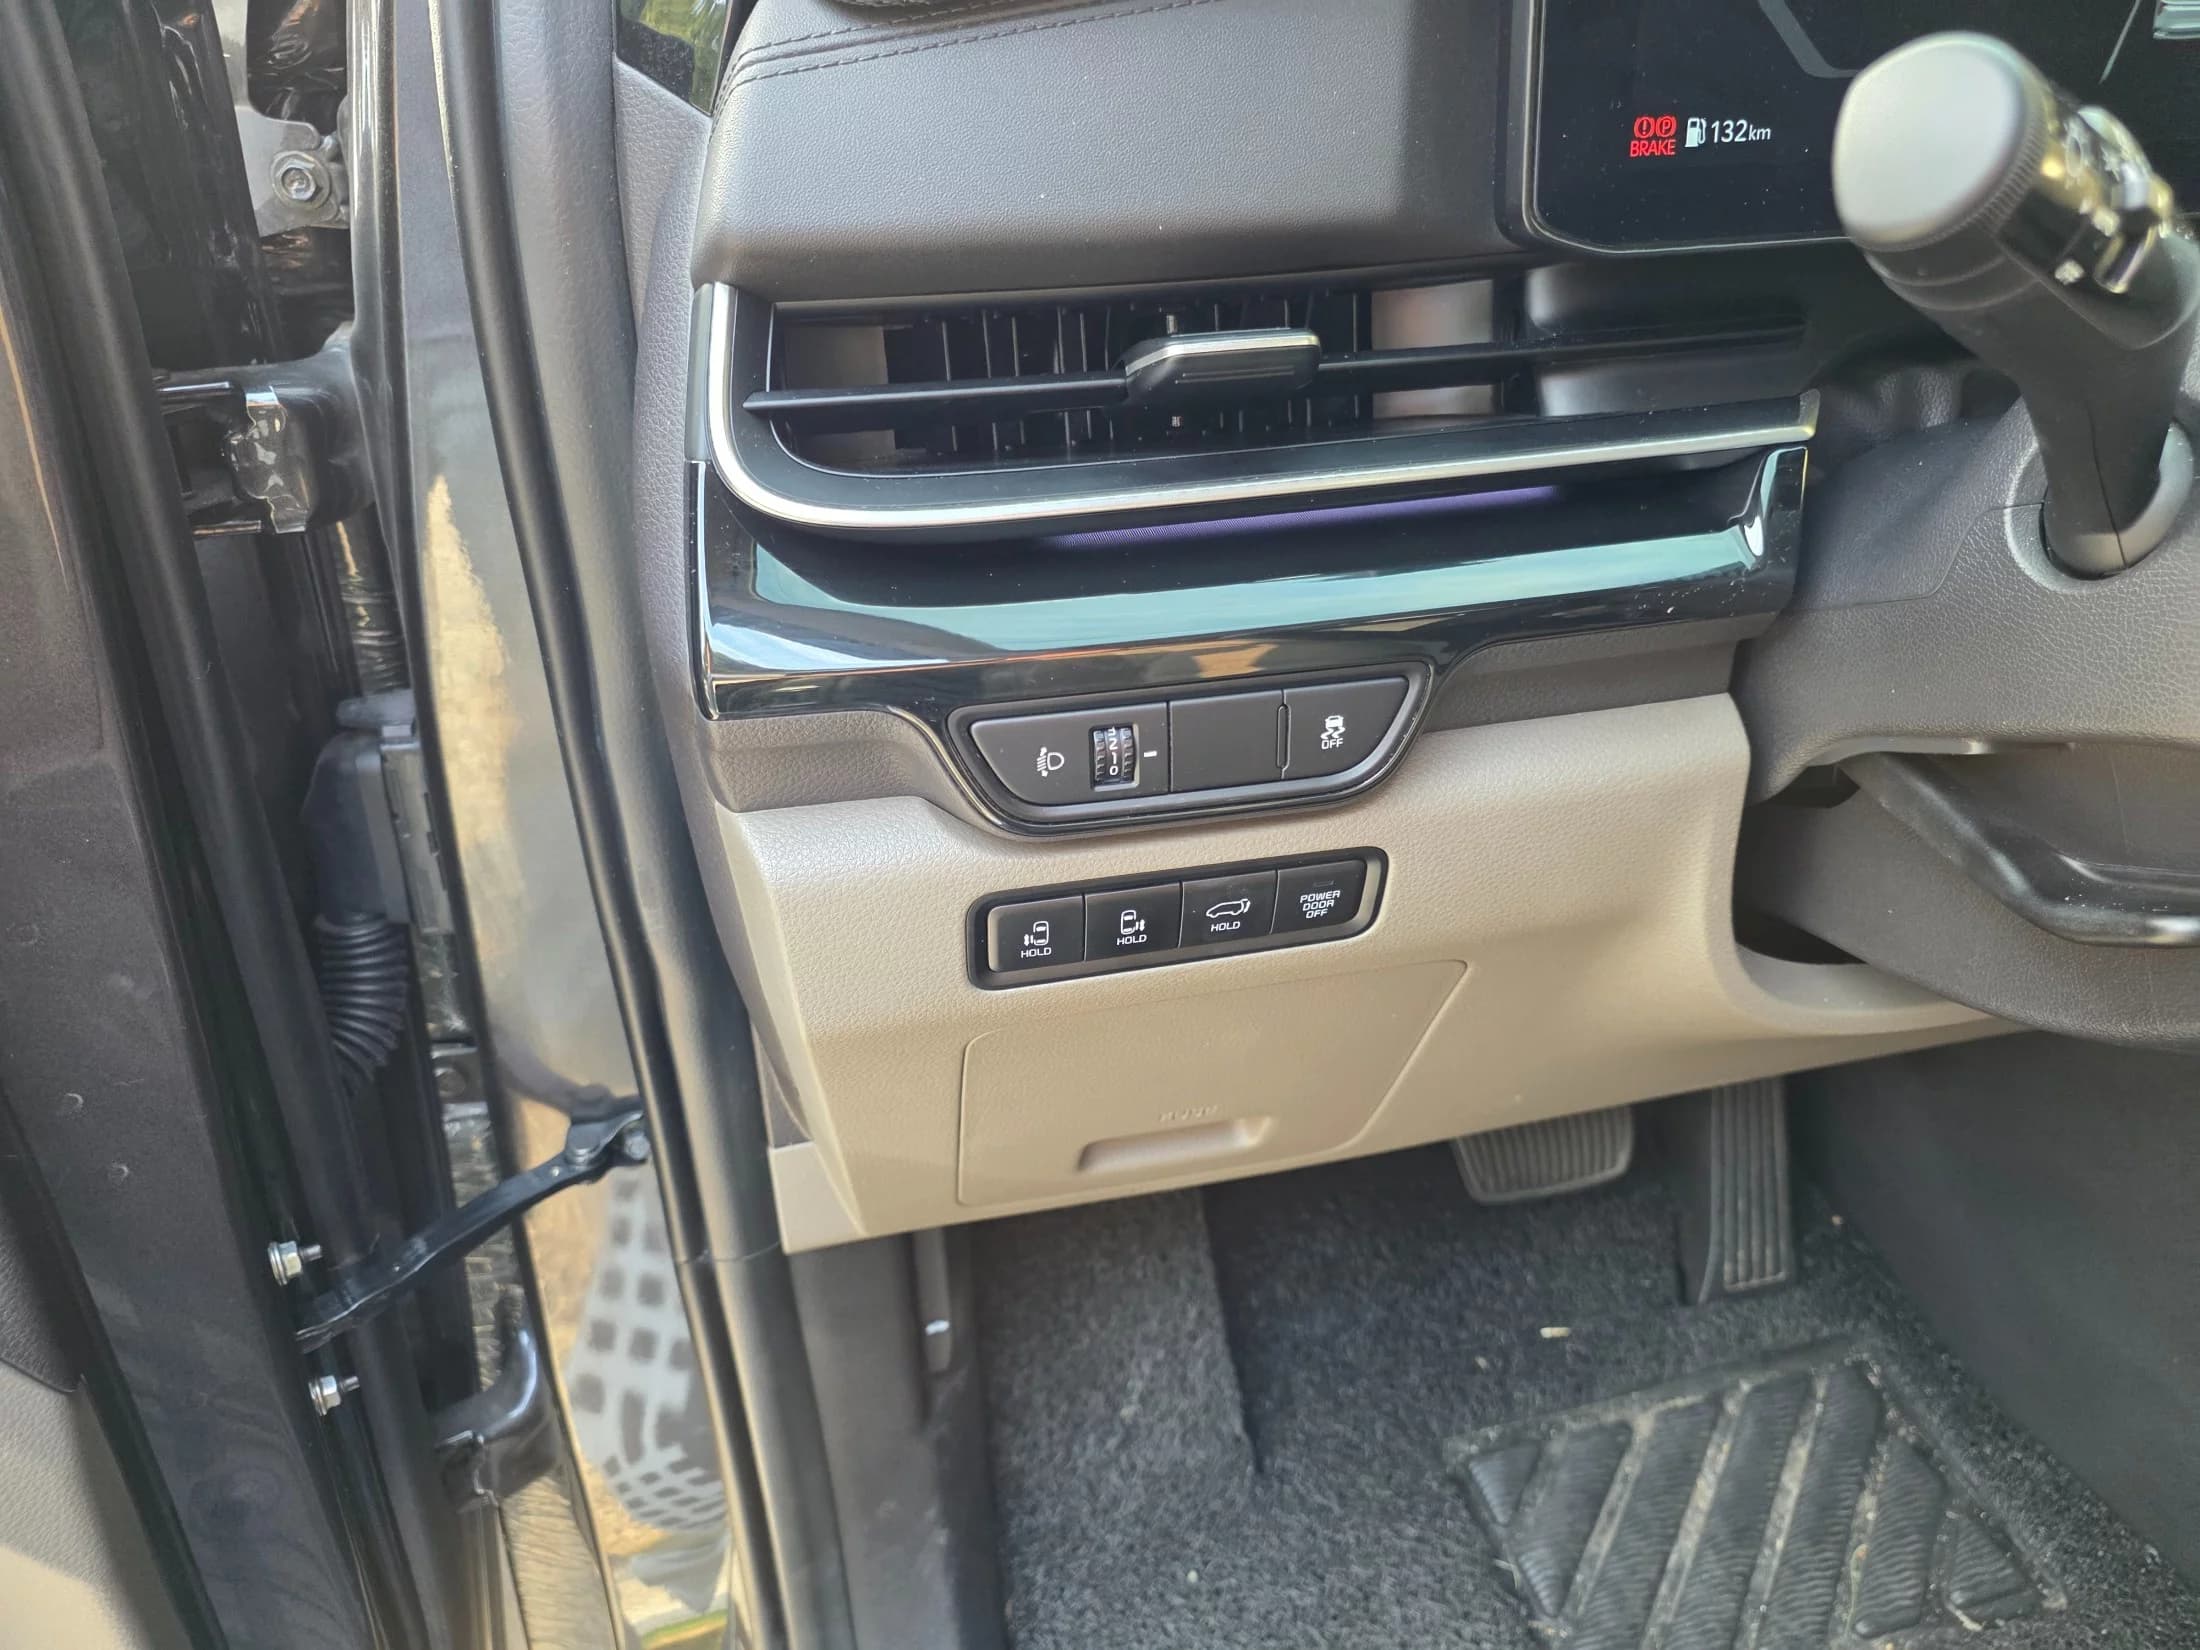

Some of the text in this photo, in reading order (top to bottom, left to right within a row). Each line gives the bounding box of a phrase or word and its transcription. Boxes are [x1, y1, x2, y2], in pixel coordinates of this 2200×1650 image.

[1629, 139, 1677, 158] BRAKE
[1109, 738, 1119, 751] 2
[1321, 737, 1344, 750] OFF
[1111, 751, 1117, 765] 1
[1299, 889, 1341, 904] POWER
[1302, 899, 1335, 912] DOOR
[1305, 908, 1329, 919] OFF
[1210, 921, 1241, 932] HOLD
[1116, 934, 1148, 946] HOLD
[1020, 947, 1052, 959] HOLD
